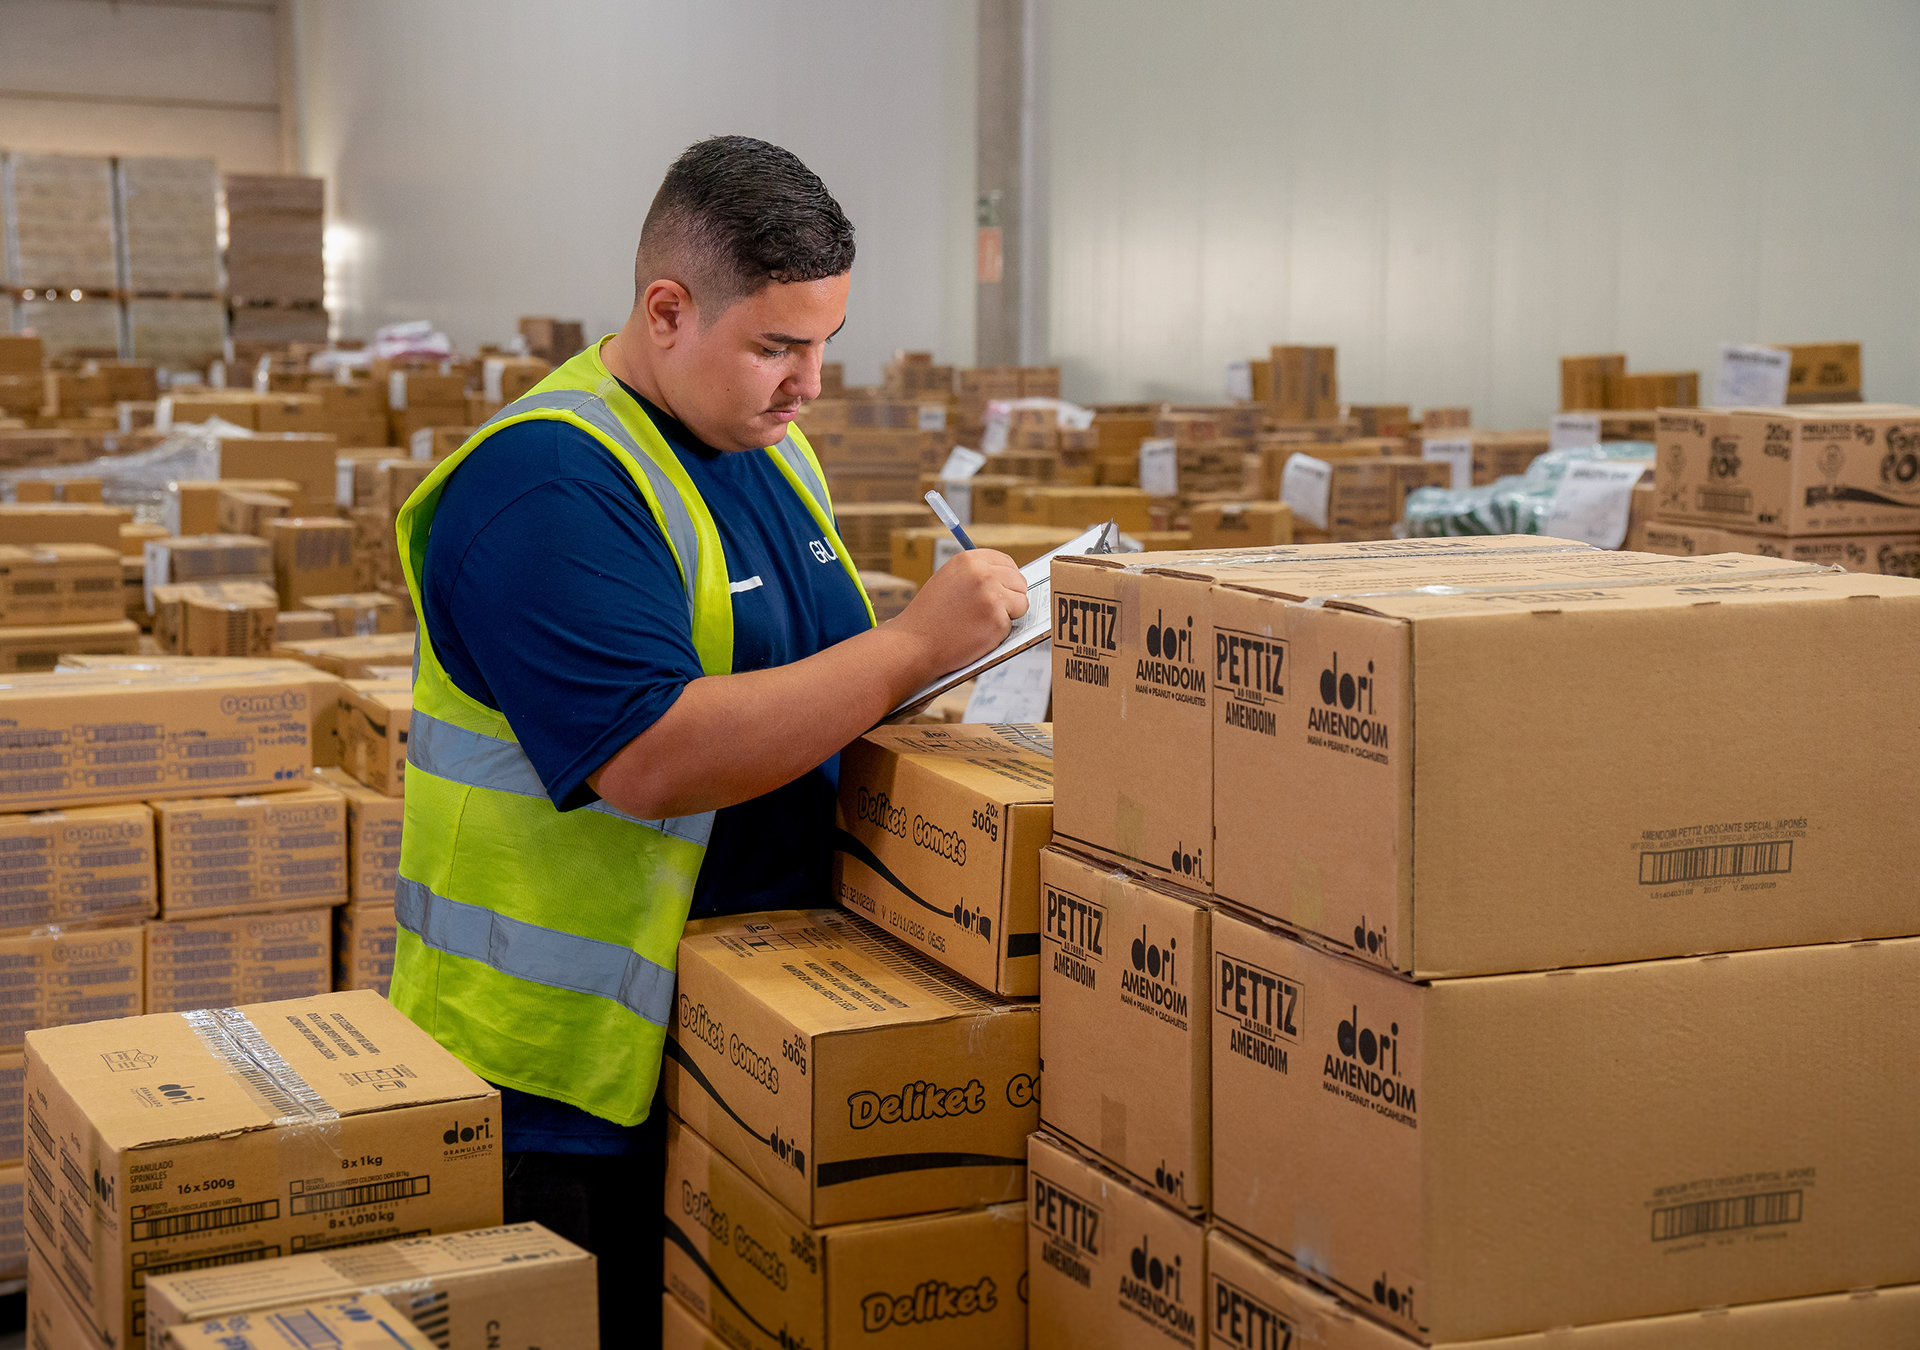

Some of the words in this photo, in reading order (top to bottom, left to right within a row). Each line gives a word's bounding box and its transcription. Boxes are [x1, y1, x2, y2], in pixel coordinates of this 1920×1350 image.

[1065, 658, 1109, 688] AMENDOIM
[1136, 659, 1206, 693] AMENDOIM
[1152, 687, 1171, 700] PEANUT
[1225, 701, 1276, 737] AMENDOIM
[1308, 707, 1388, 750] AMENDOIM
[857, 786, 907, 838] Deliket
[971, 810, 998, 842] 500g
[985, 802, 999, 819] 20x
[1641, 828, 1677, 841] AMENDOIM
[1678, 825, 1702, 837] PETTIZ
[1703, 822, 1742, 835] CROCANTE
[1743, 820, 1772, 832] SPECIAL
[1053, 952, 1096, 991] AMENDOIM
[1121, 969, 1188, 1018] AMENDOIM
[1137, 1001, 1155, 1016] PEANUT
[680, 993, 724, 1055] Deliket
[782, 1038, 807, 1076] 500g
[794, 1034, 807, 1053] 20x
[1230, 1028, 1288, 1075] AMENDOIM
[1323, 1054, 1417, 1113] AMENDOIM
[847, 1079, 986, 1131] Deliket
[1345, 1090, 1370, 1109] PEANUT
[341, 1159, 349, 1169] 8
[350, 1160, 358, 1168] x
[443, 1143, 493, 1156] GRANULADO
[130, 1160, 174, 1175] GRANULADO
[130, 1171, 168, 1184] SPRINKLES
[305, 1182, 335, 1192] GRANULADO
[336, 1177, 359, 1188] CONFEITO
[359, 1174, 383, 1184] COLORIDO
[384, 1172, 395, 1180] DORI
[130, 1181, 163, 1194] GRANULE
[180, 1201, 208, 1213] CHOCOLATE
[329, 1219, 337, 1229] 8
[338, 1220, 346, 1228] x
[348, 1212, 377, 1227] 1,010
[378, 1210, 395, 1223] kg
[1042, 1241, 1091, 1290] AMENDOIM
[860, 1276, 999, 1333] Deliket
[1119, 1274, 1196, 1338] AMENDOIM
